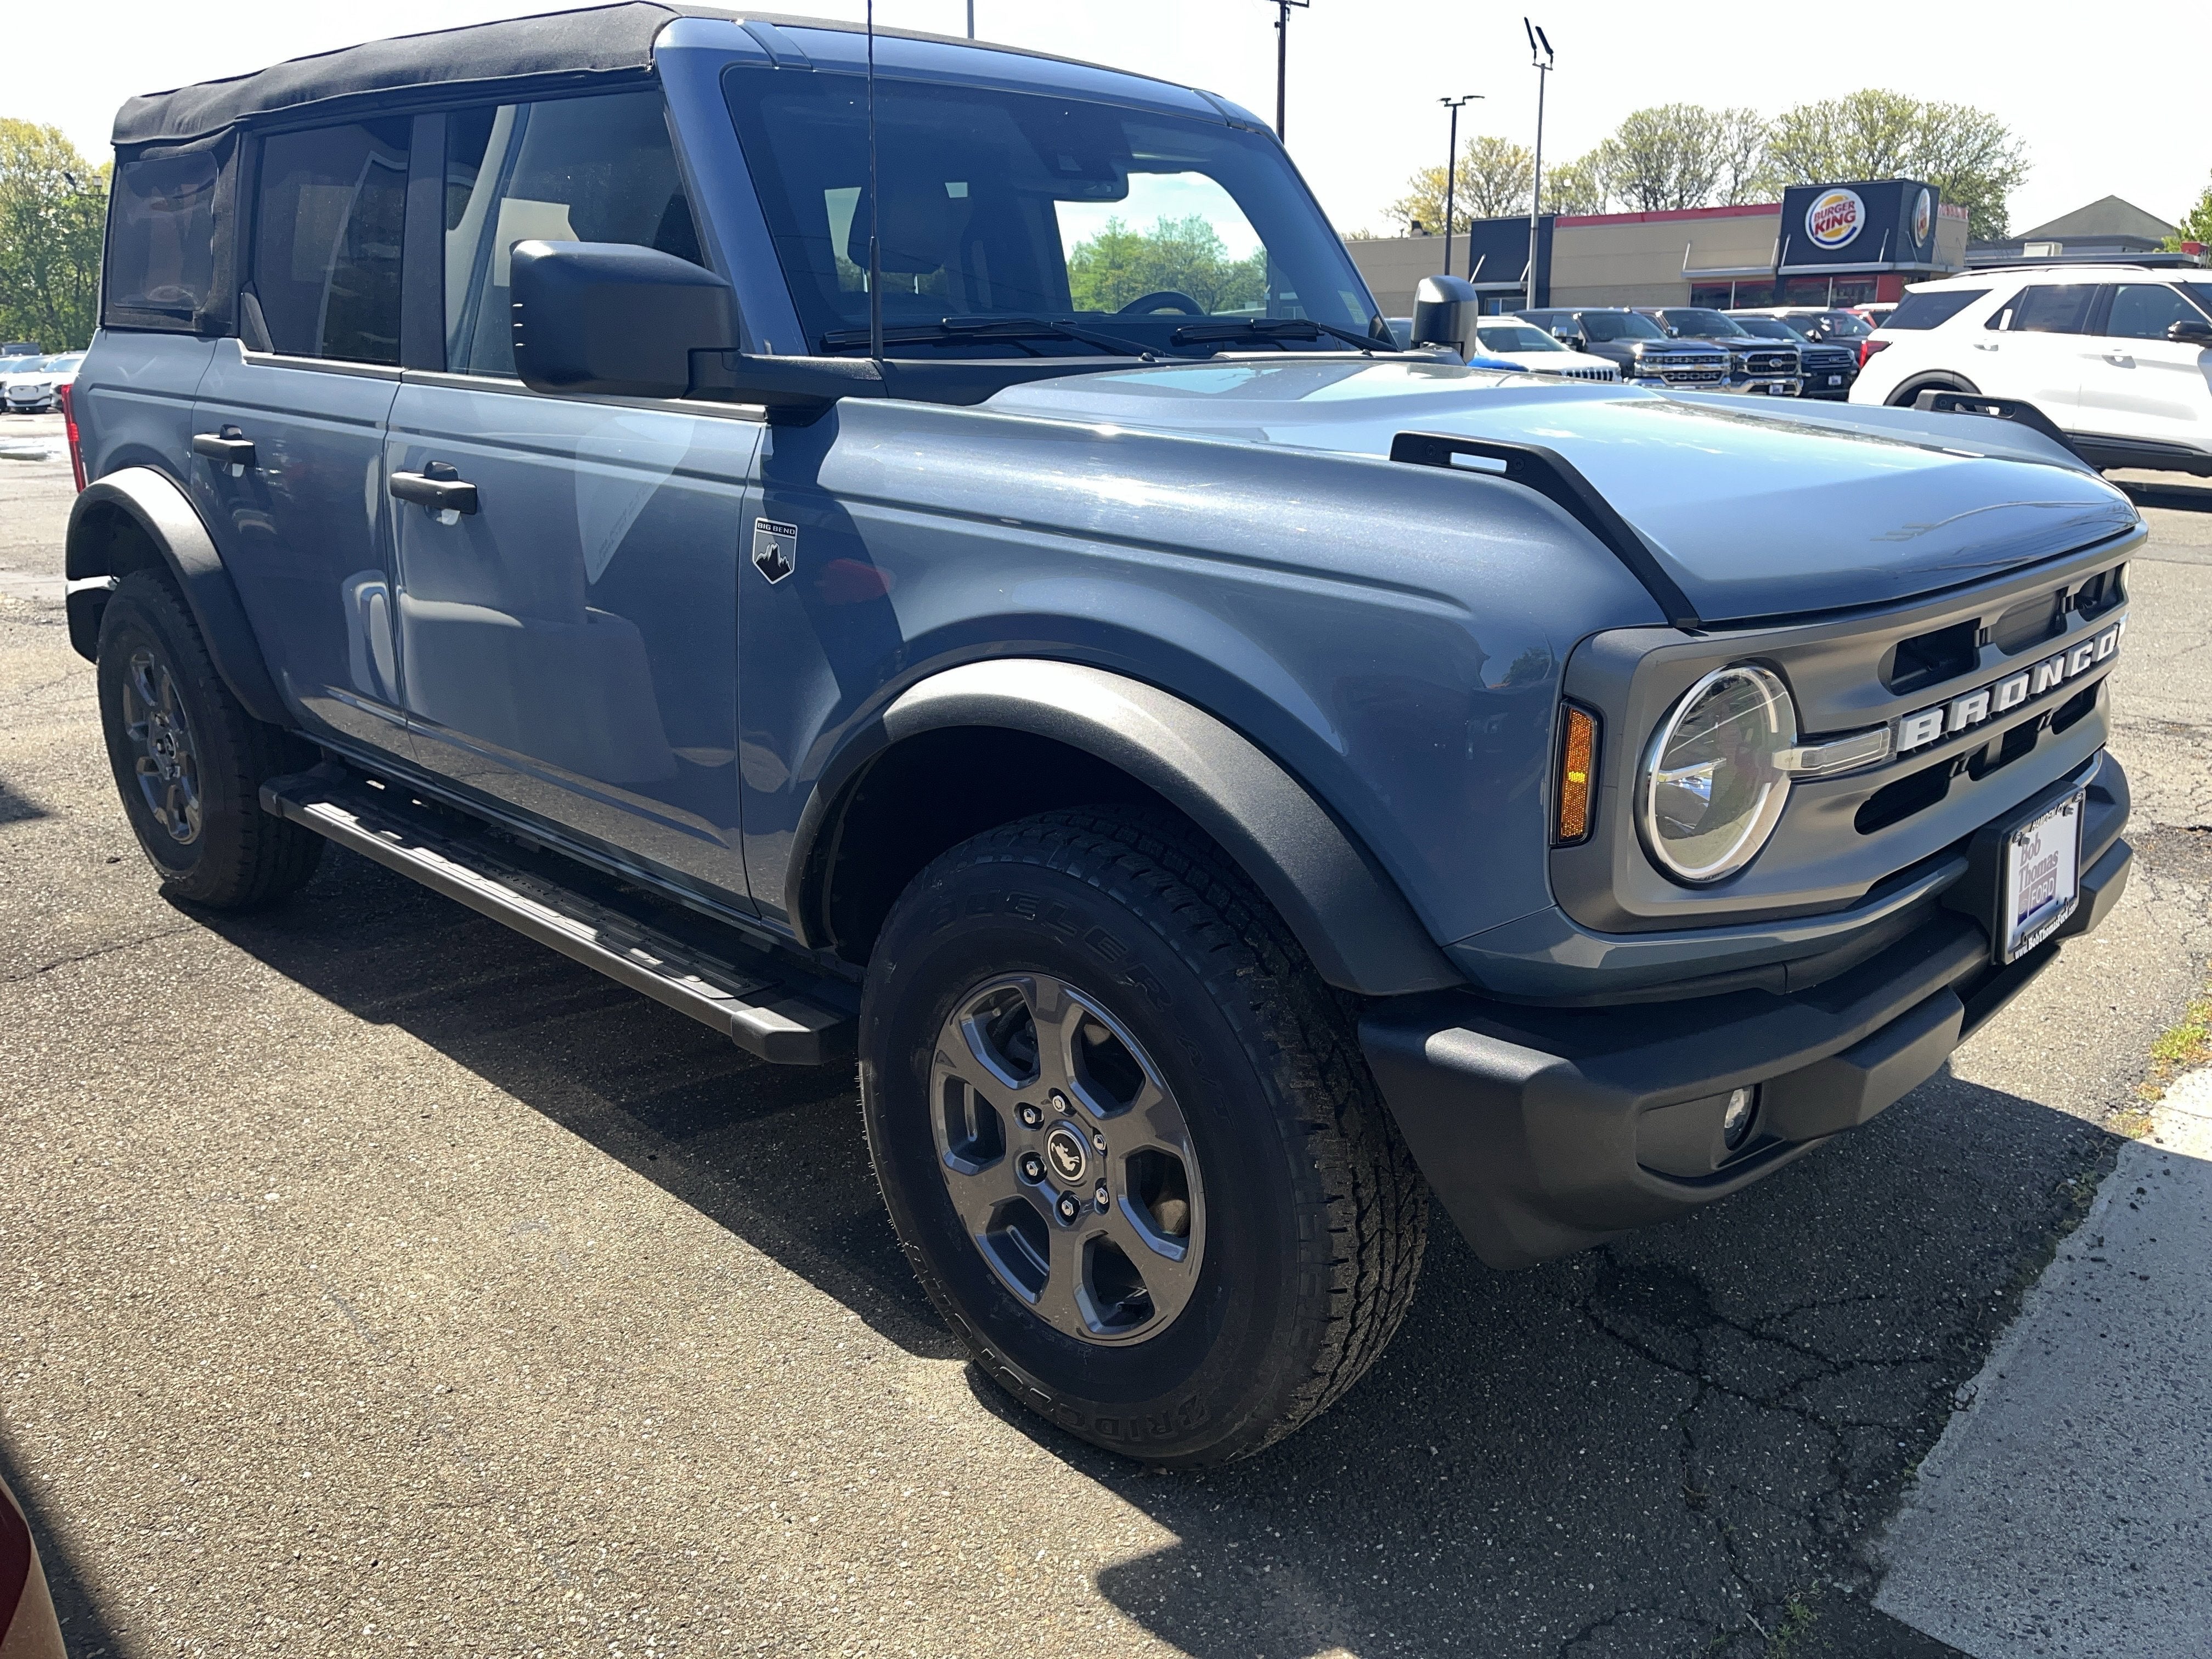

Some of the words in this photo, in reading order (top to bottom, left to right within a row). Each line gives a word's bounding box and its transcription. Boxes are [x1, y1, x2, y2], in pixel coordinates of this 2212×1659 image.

[1814, 201, 1855, 222] BURGER
[1815, 211, 1856, 235] KING
[772, 526, 795, 535] BEND
[1896, 623, 2119, 752] BRONCO
[2020, 832, 2041, 867] Bob
[2019, 850, 2058, 893] Thomas
[2031, 877, 2055, 909] FORD
[928, 889, 1174, 1013] DUELER
